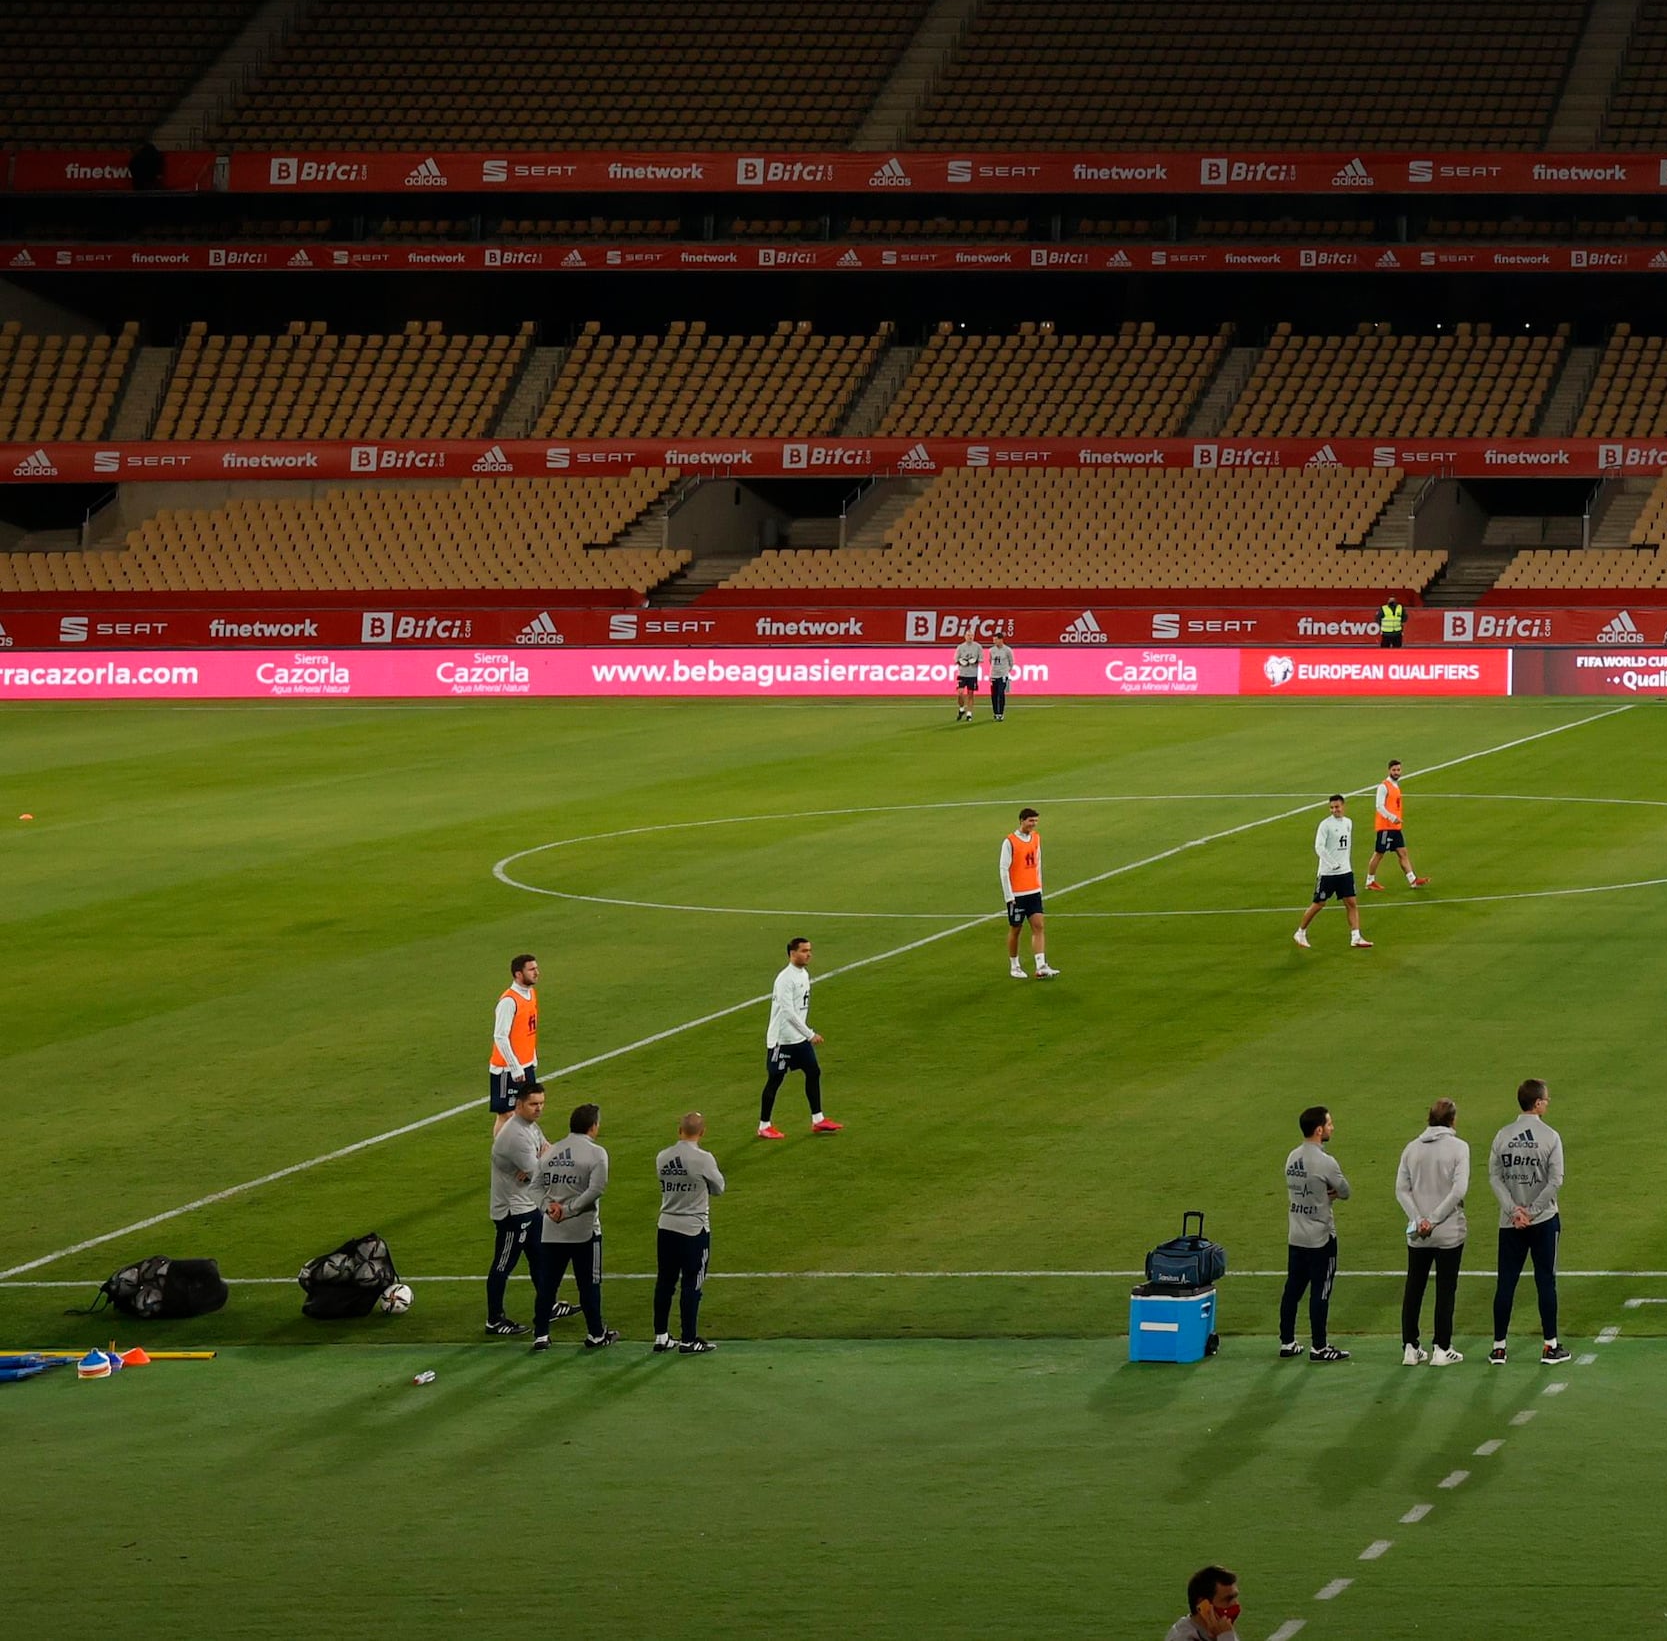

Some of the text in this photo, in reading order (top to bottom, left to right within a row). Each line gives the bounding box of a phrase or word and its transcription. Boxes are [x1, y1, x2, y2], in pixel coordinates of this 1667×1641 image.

[608, 163, 702, 178] finetwork
[980, 167, 1040, 176] SEAT
[1533, 165, 1625, 180] finetwork
[869, 175, 911, 186] adidas
[681, 253, 736, 262] finetwork
[128, 457, 191, 465] SEAT
[223, 452, 317, 467] finetwork
[665, 449, 752, 463] finetwork
[996, 452, 1051, 460] SEAT
[1079, 450, 1163, 463] finetwork
[1485, 450, 1569, 463] finetwork
[14, 465, 57, 475] adidas
[472, 461, 513, 471] adidas
[97, 624, 167, 634] SEAT
[209, 619, 318, 637] finetwork
[646, 622, 715, 632] SEAT
[756, 618, 862, 635] finetwork
[1188, 621, 1256, 631] SEAT
[516, 631, 563, 644] adidas
[1060, 629, 1107, 642] adidas
[1597, 630, 1644, 643] adidas
[295, 654, 328, 664] Sierra
[474, 653, 508, 663] Sierra
[1143, 652, 1176, 662] Sierra
[1576, 656, 1602, 667] FIFA
[1602, 656, 1647, 667] WORLD
[256, 662, 349, 683] Cazorla
[436, 661, 529, 683] Cazorla
[1105, 660, 1197, 681] Cazorla
[1299, 665, 1479, 679] EUROPEAN QUALIFIERS
[271, 685, 291, 694] Agua
[451, 684, 470, 693] Agua
[1120, 683, 1140, 692] Agua
